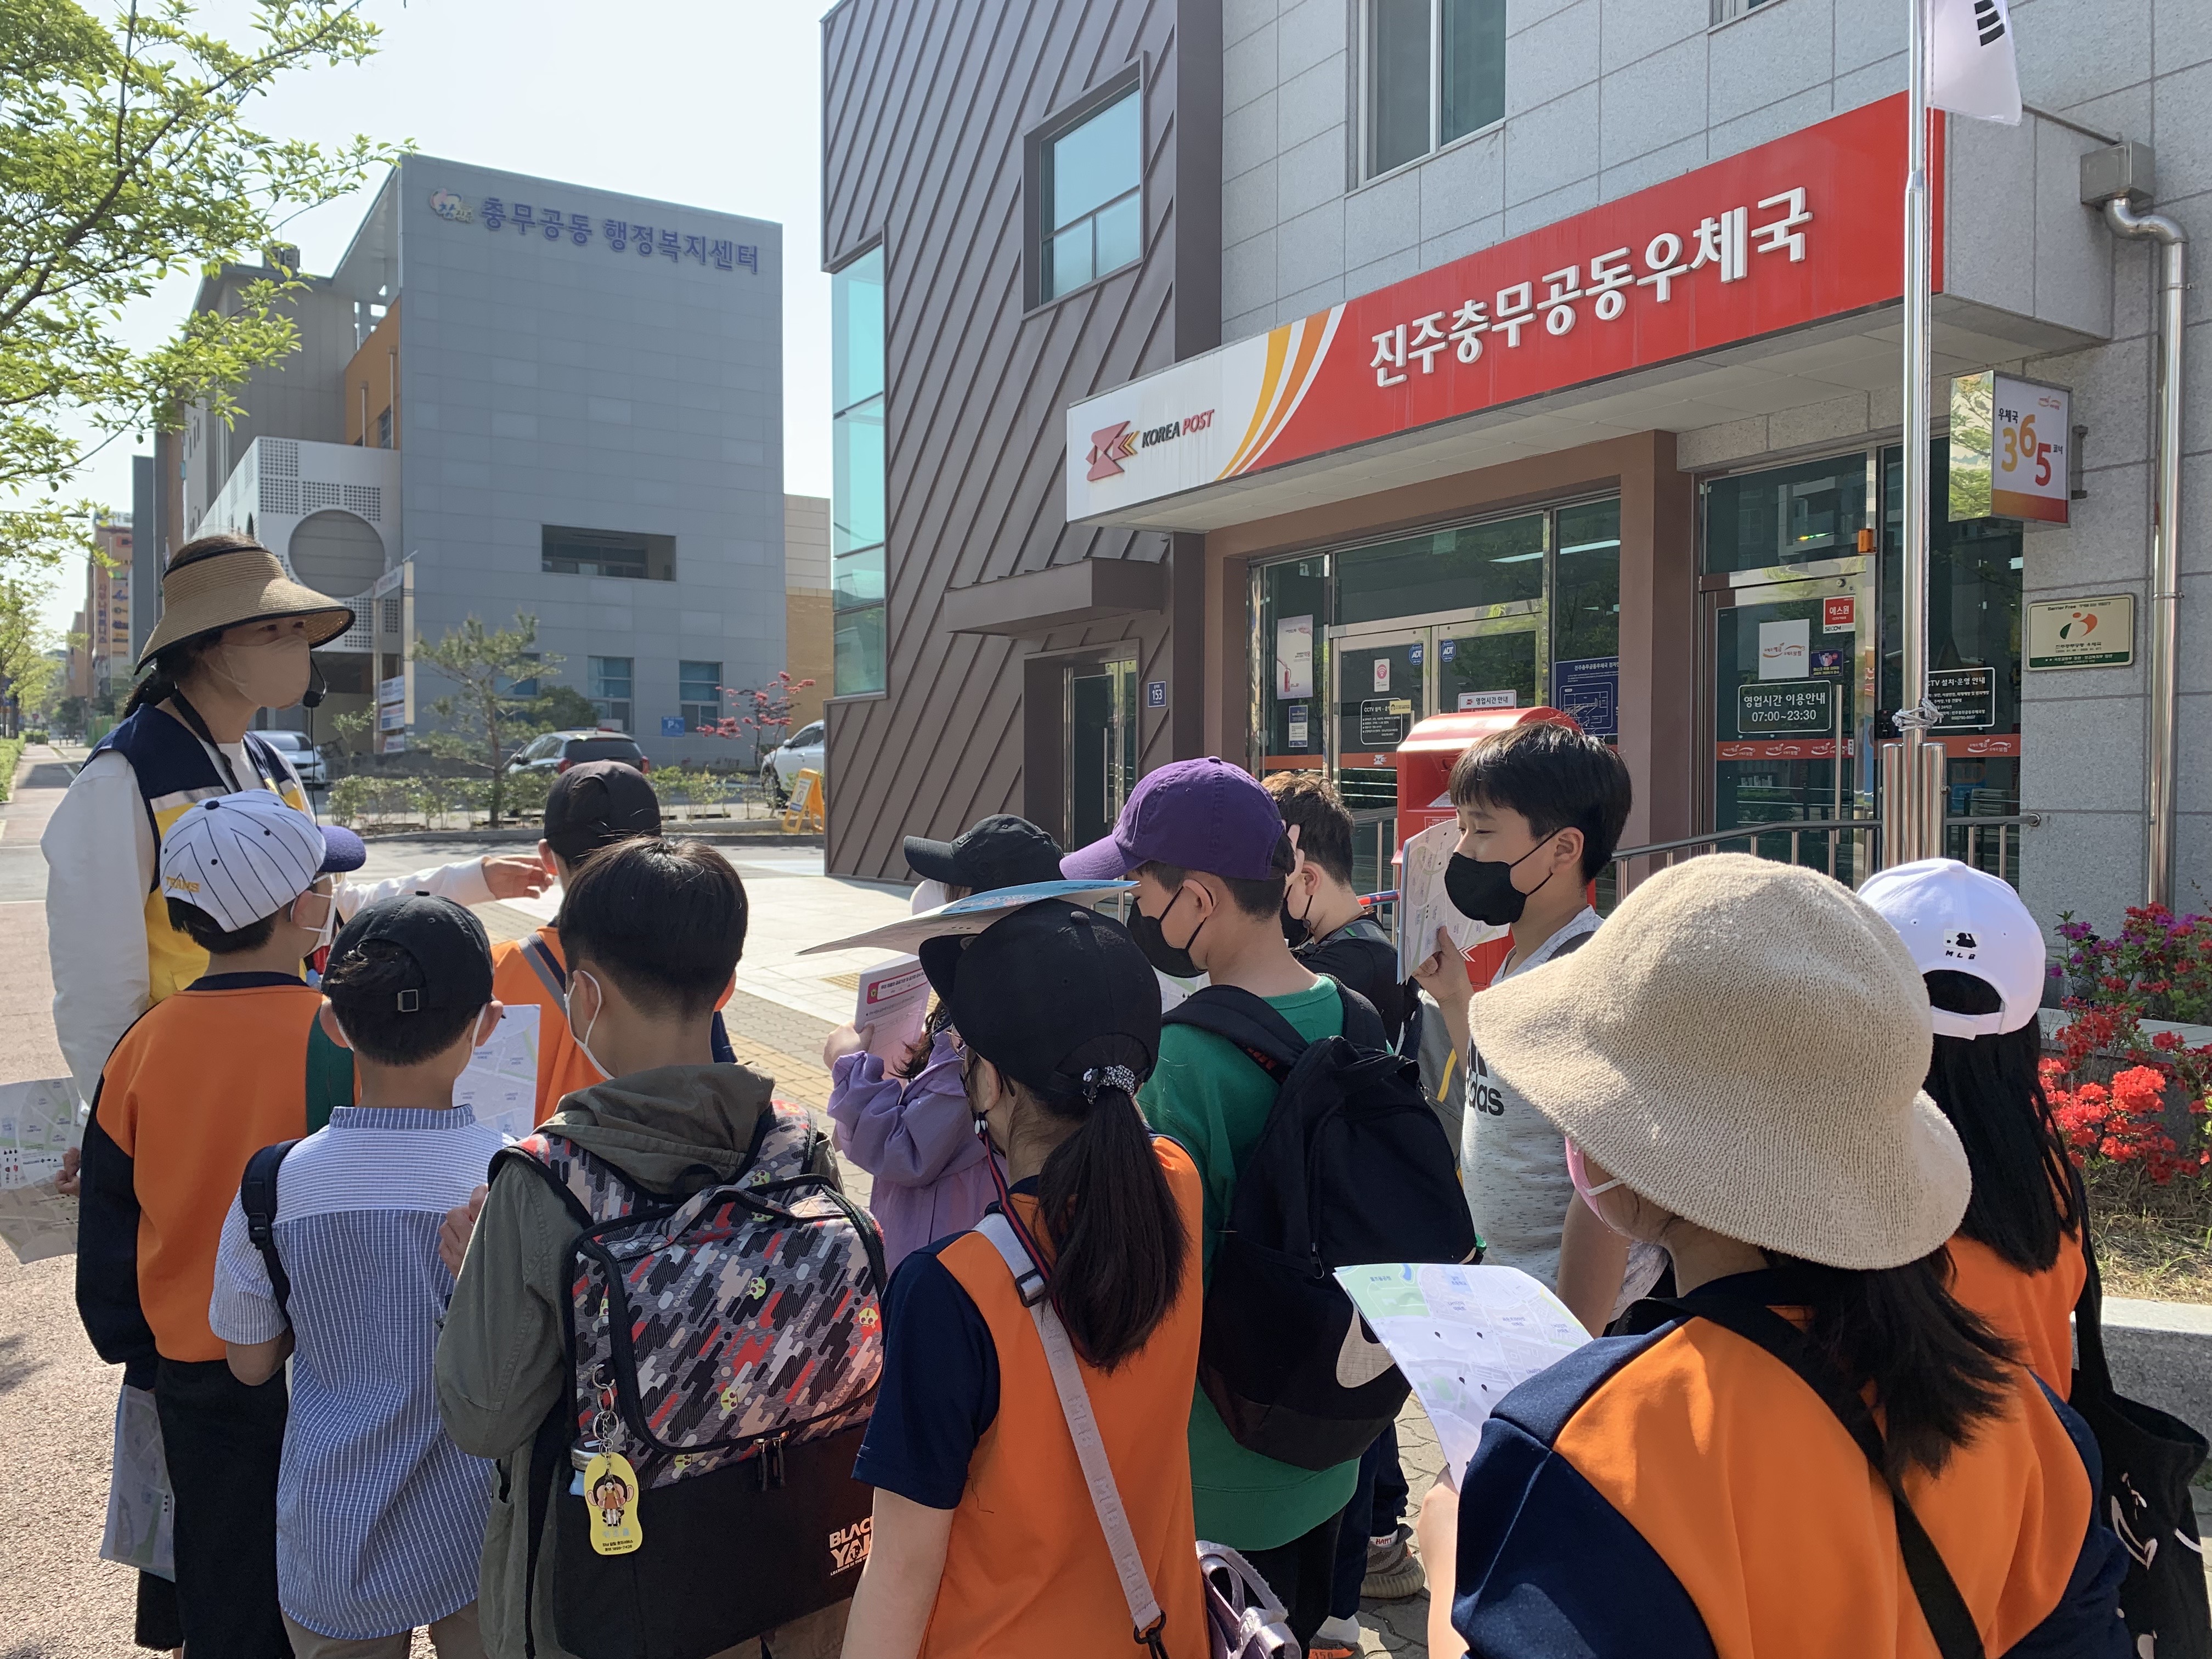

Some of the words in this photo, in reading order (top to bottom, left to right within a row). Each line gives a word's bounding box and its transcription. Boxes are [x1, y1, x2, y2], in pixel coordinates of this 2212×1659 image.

[481, 196, 592, 246] 충무공동
[603, 219, 759, 274] 행정복지센터
[1370, 187, 1813, 388] 진주충무공동우체국
[1998, 408, 2018, 424] 우체국
[1141, 421, 1180, 448] KOREA
[1181, 409, 1215, 436] POST
[1829, 605, 1849, 615] 에스원
[1412, 650, 1422, 659] ADT
[1443, 646, 1454, 655] ADT
[1972, 677, 1985, 685] 안내
[1152, 689, 1162, 701] 153
[1476, 697, 1497, 705] 영업시간
[1743, 695, 1782, 708] 영업시간
[1786, 692, 1826, 706] 이용안내
[1752, 709, 1816, 722] 07:00~23:30
[1945, 950, 1976, 960] MLB
[1468, 1073, 1504, 1116] das
